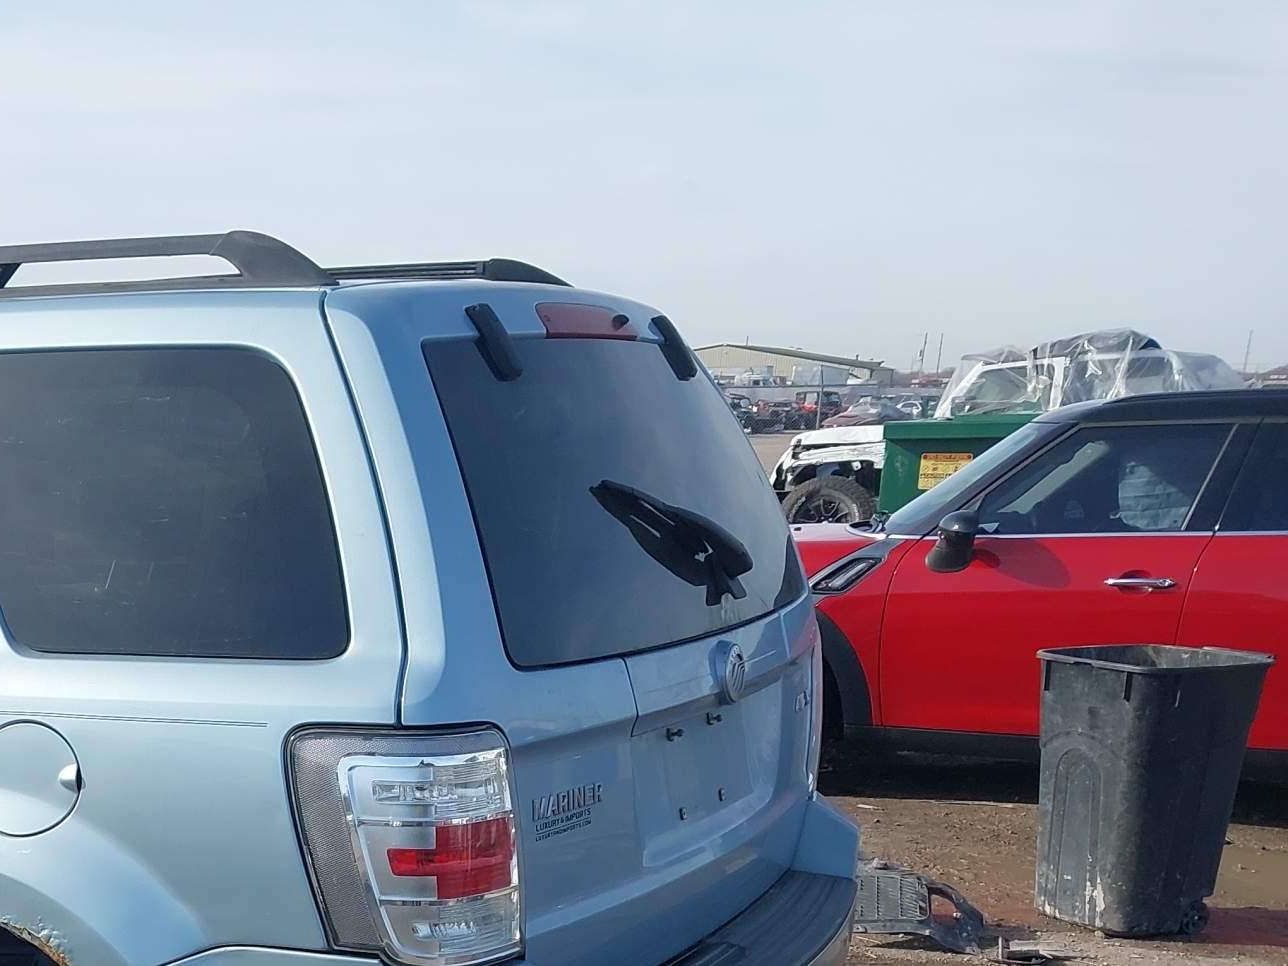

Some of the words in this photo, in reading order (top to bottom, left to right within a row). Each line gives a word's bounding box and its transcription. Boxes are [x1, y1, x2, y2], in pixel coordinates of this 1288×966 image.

[532, 783, 603, 822] MARINER
[535, 819, 560, 832] LUXURY
[565, 807, 592, 823] IMPORTS
